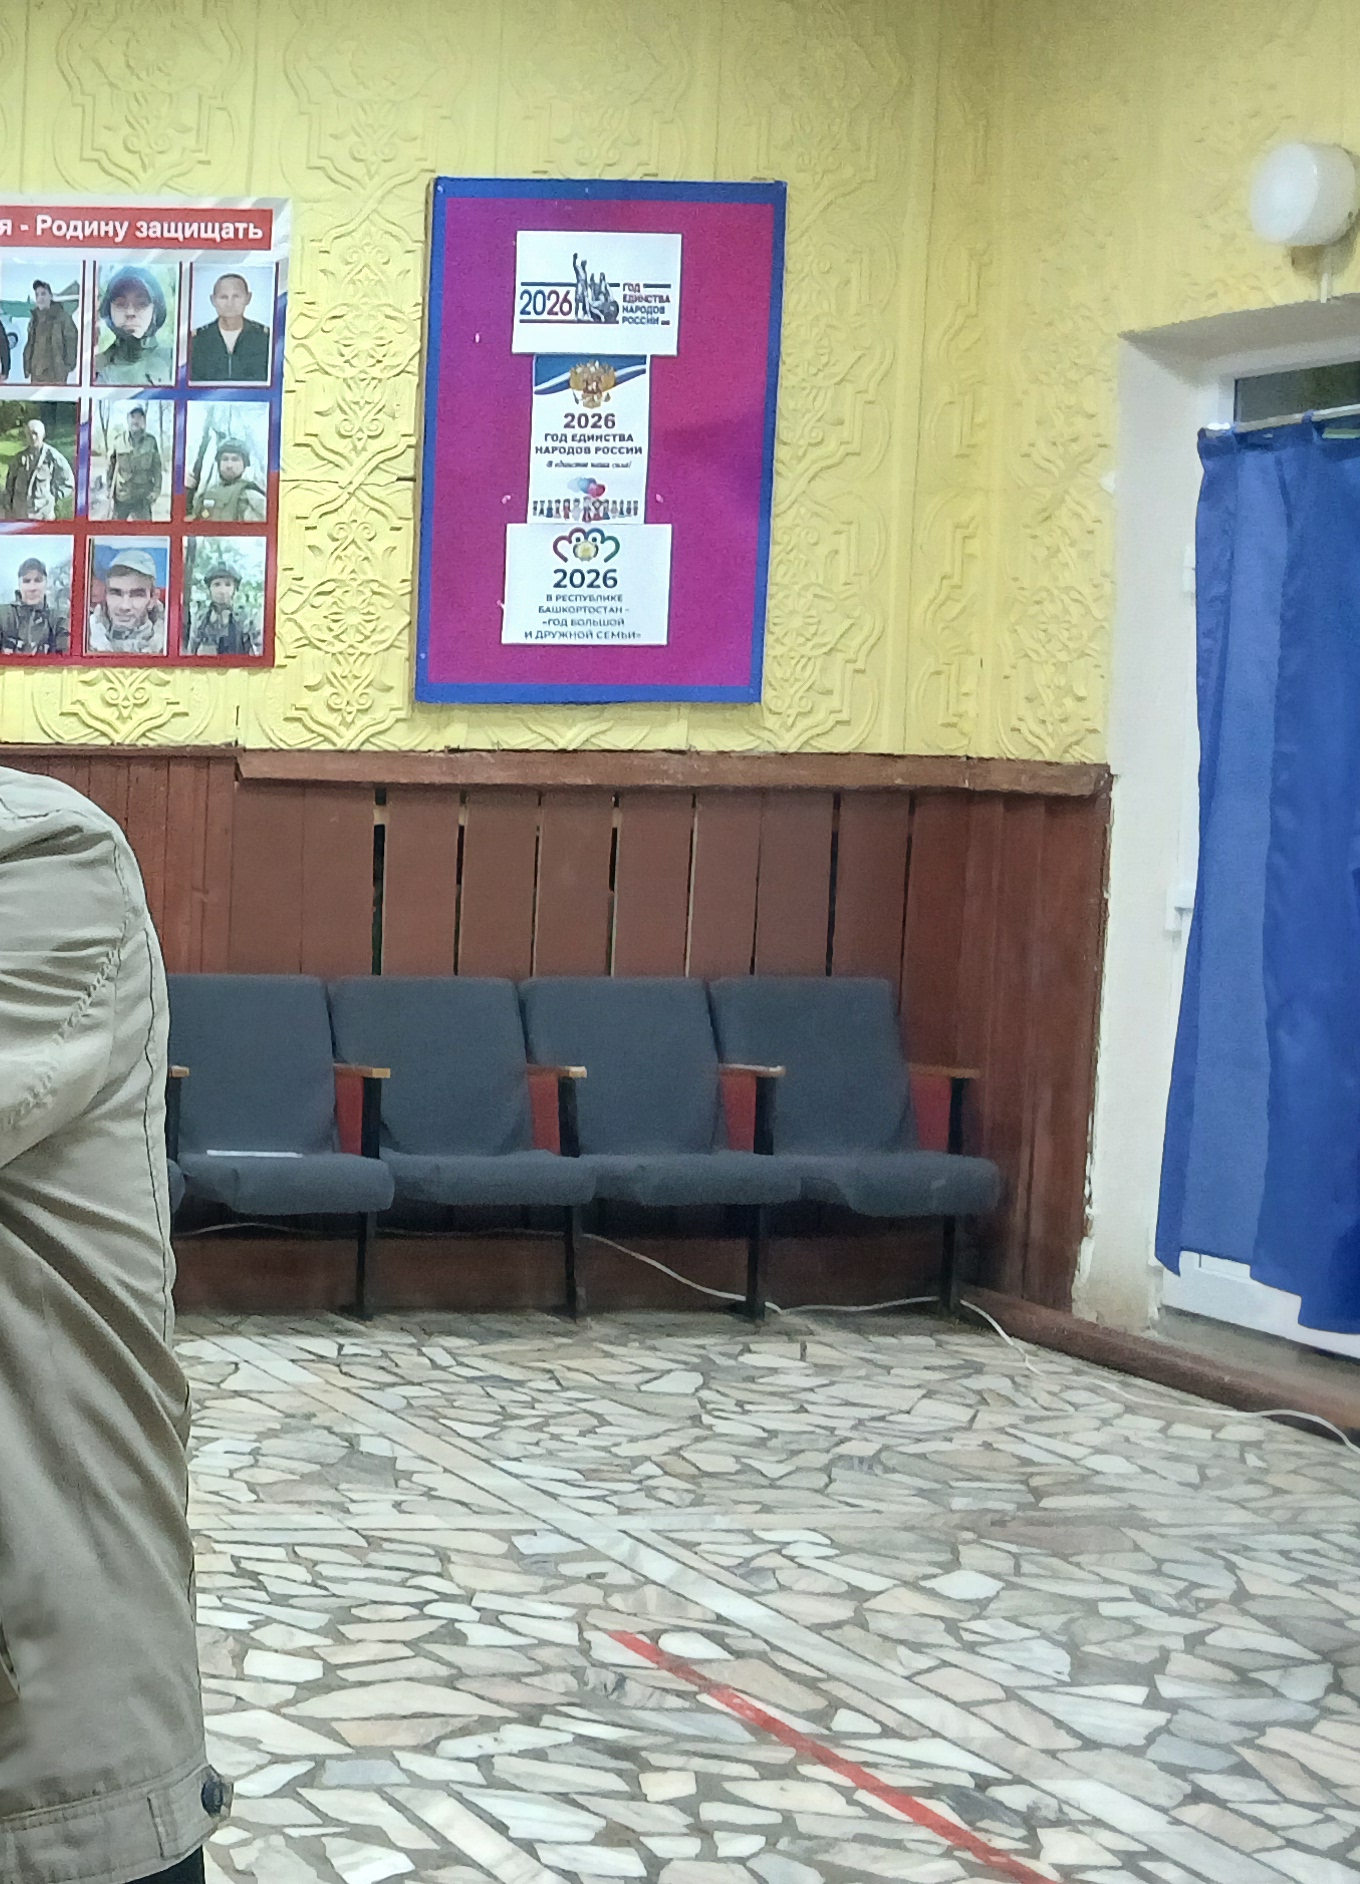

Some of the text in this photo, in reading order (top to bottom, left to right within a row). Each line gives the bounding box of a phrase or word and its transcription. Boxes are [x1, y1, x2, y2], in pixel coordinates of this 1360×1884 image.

[35, 214, 129, 242] Родину
[135, 219, 264, 242] защищать
[622, 282, 641, 293] ГОД
[519, 289, 573, 316] 2026
[622, 294, 671, 304] ЕДИНСТВА
[622, 305, 666, 315] НАРОДОВ
[622, 316, 659, 325] РОССИИ
[563, 412, 616, 429] 2026
[544, 433, 634, 443] ГОД ЕДИНСТВА
[535, 446, 643, 456] НАРОДОВ РОССИИ
[552, 568, 618, 589] 2026
[546, 594, 623, 603] В РЕСПУБЛИКЕ
[538, 605, 623, 614] БАШКОРТОСТАН
[570, 617, 625, 627] БОЛЬШОЙ
[524, 630, 533, 639] И
[535, 630, 594, 640] ДРУЖНОЙ
